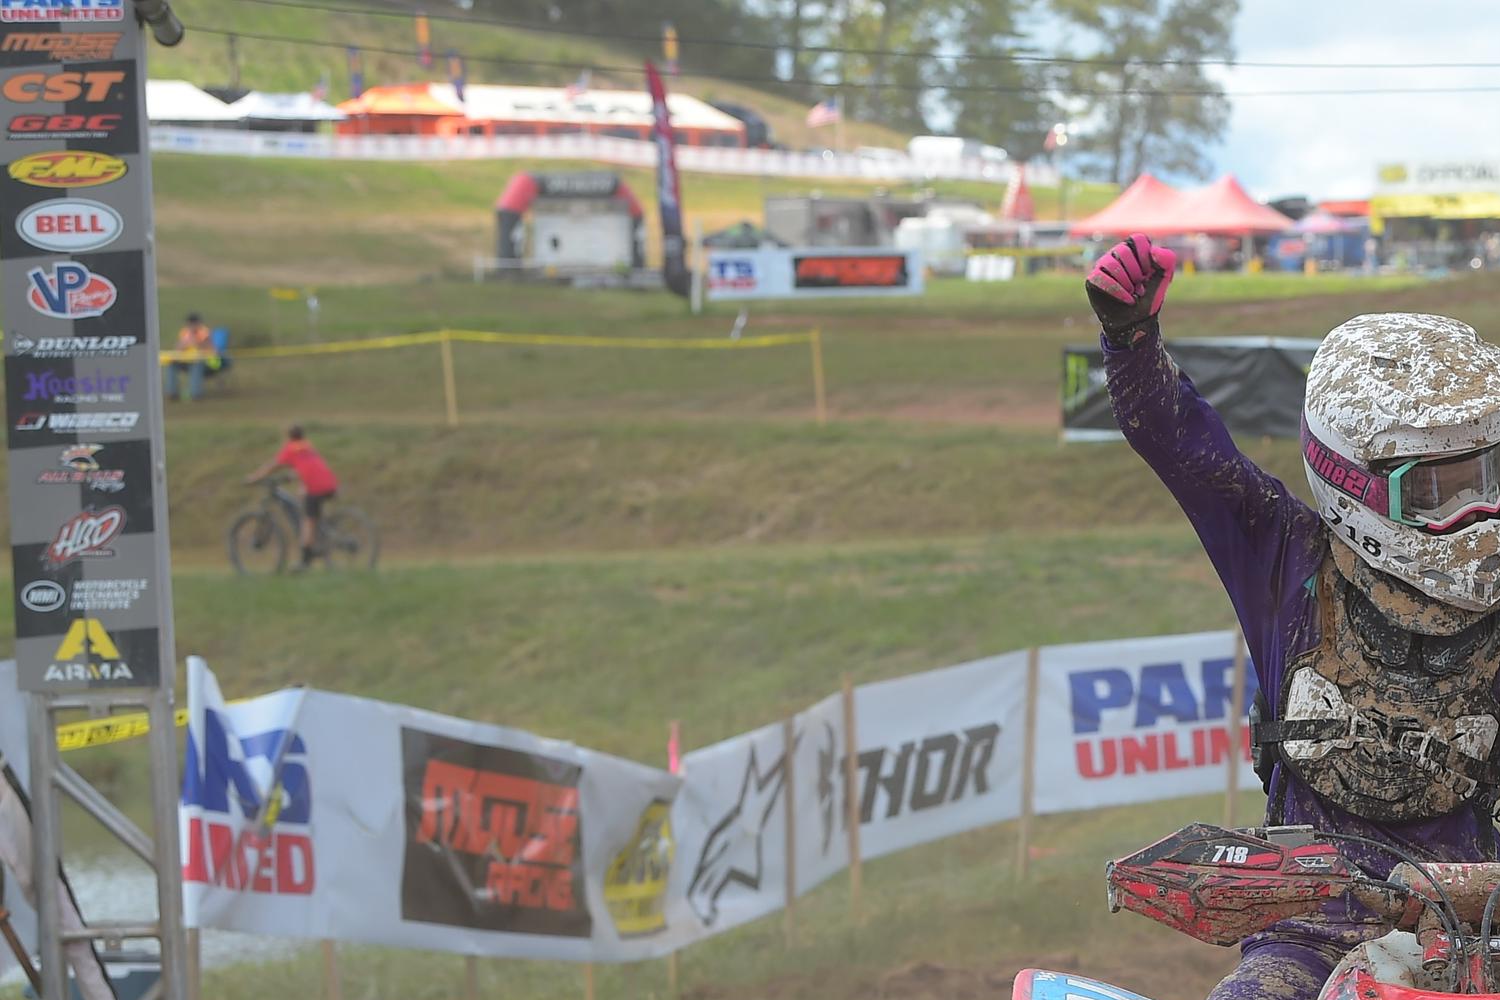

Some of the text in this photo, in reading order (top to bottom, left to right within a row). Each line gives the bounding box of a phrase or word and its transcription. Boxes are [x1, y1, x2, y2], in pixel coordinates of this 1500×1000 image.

[2, 9, 121, 20] UNLIMITED
[2, 33, 122, 51] MOOSE
[4, 71, 125, 102] CST
[9, 114, 122, 131] GBC
[9, 157, 125, 178] FMF
[36, 216, 104, 233] BELL
[32, 266, 87, 314] VP
[37, 336, 136, 349] DUNLOP
[24, 371, 130, 400] Hoosier
[48, 413, 139, 428] WISECO
[1306, 440, 1370, 498] Nine2
[1326, 506, 1382, 558] 718
[73, 580, 148, 590] MOTORCYCLE
[72, 591, 140, 600] MECHANICS
[70, 602, 131, 610] INSTITUTE
[43, 664, 134, 681] ARMA
[839, 722, 1001, 832] THOR
[1212, 846, 1249, 863] 718
